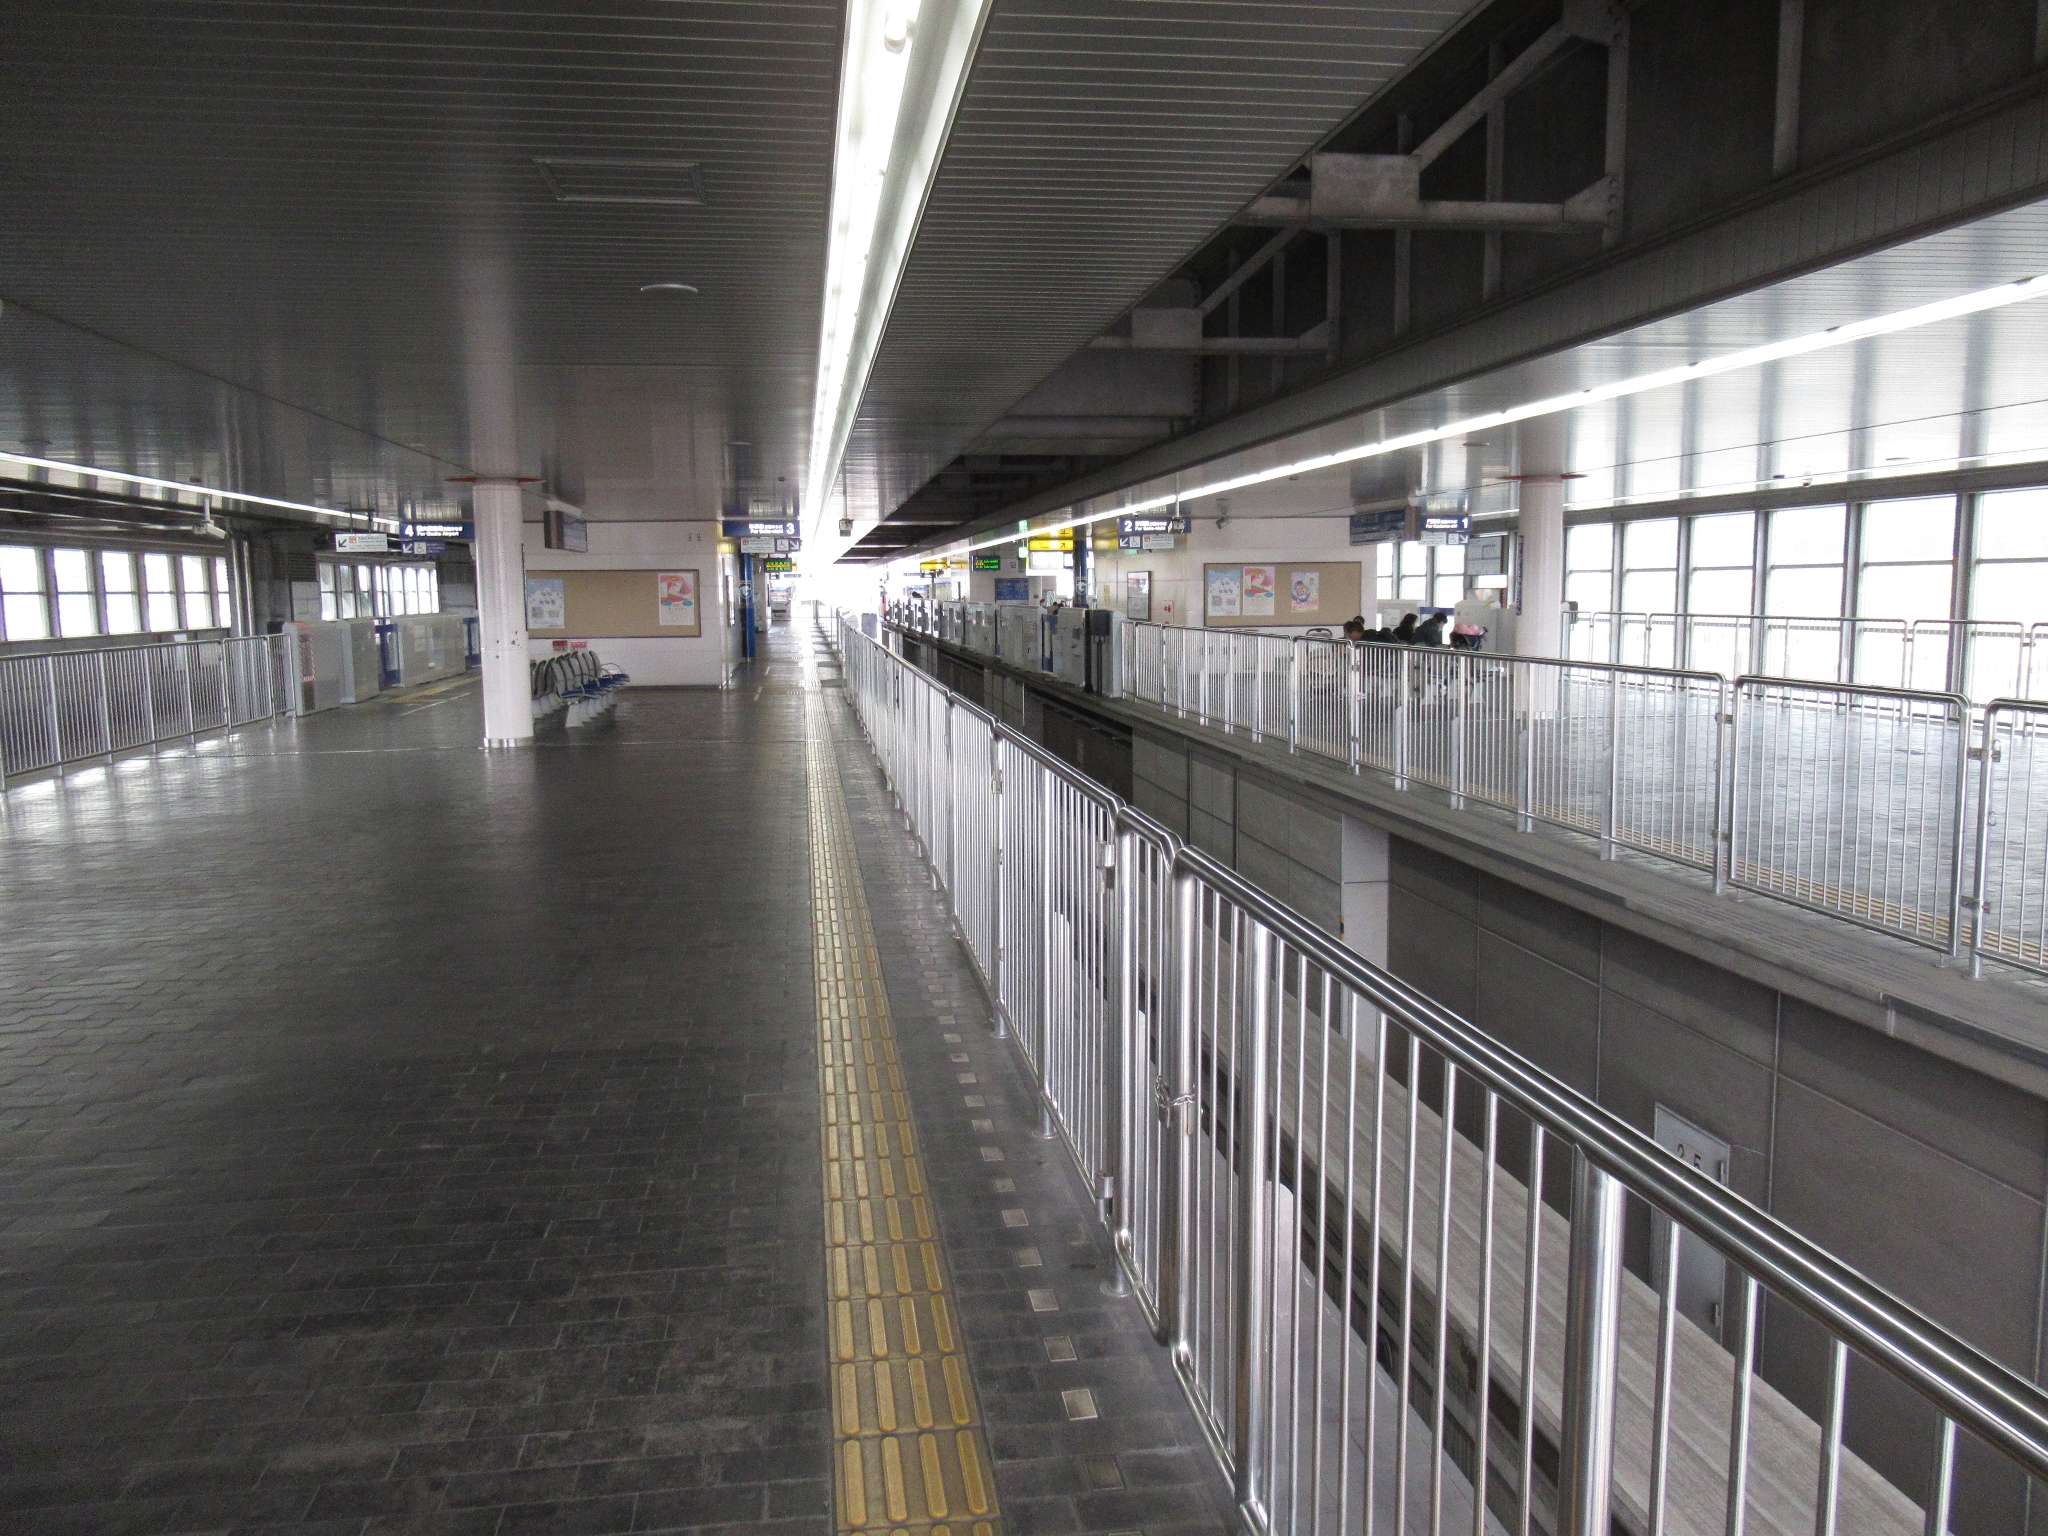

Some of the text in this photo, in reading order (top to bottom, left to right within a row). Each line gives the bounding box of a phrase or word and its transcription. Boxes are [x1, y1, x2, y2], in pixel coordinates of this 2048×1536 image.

[1124, 520, 1132, 532] 2
[1462, 517, 1469, 528] 1
[405, 524, 414, 537] 4
[786, 523, 795, 535] 3
